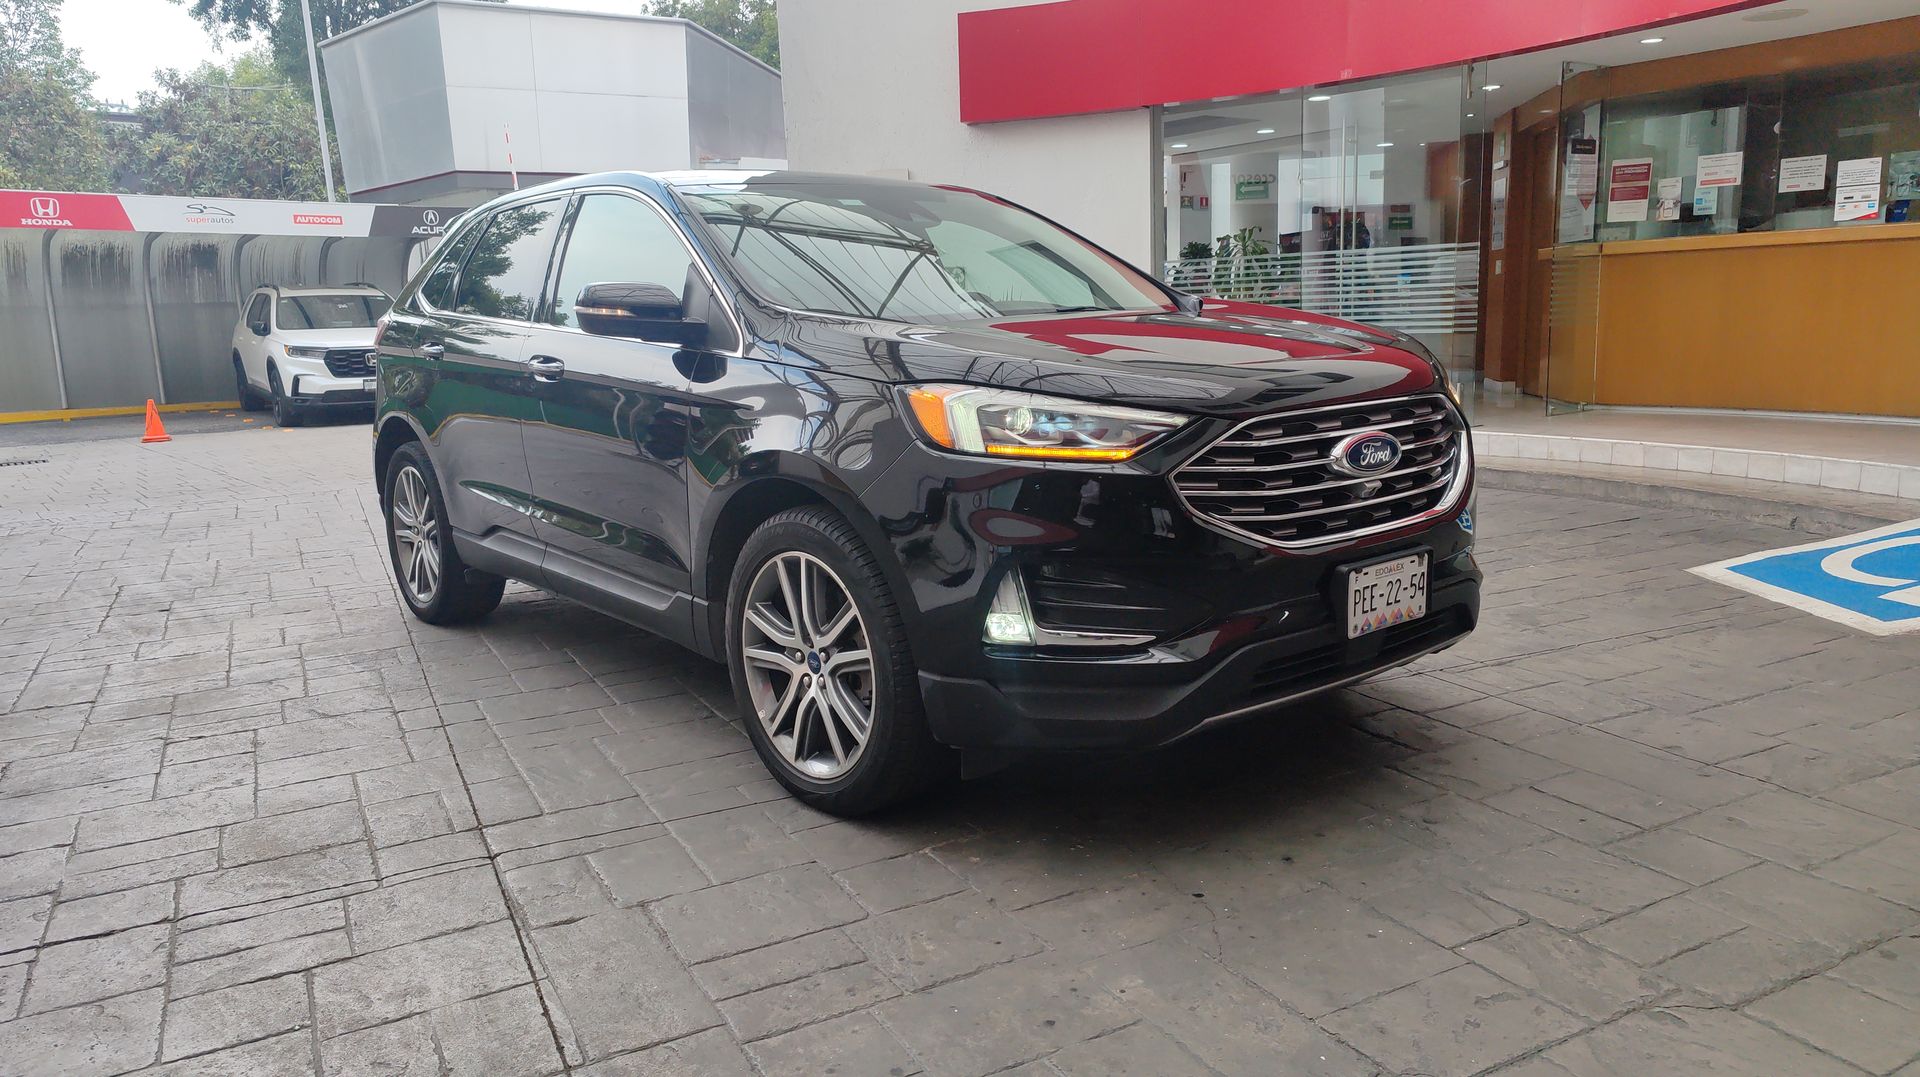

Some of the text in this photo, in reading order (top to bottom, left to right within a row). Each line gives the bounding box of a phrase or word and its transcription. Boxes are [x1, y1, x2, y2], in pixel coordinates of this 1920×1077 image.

[20, 218, 73, 227] HONDA
[185, 216, 235, 225] superautos
[295, 215, 341, 224] AUTOCOM
[411, 226, 446, 235] ACUR
[1360, 441, 1390, 466] Ford
[1353, 571, 1425, 617] PEE-22-54
